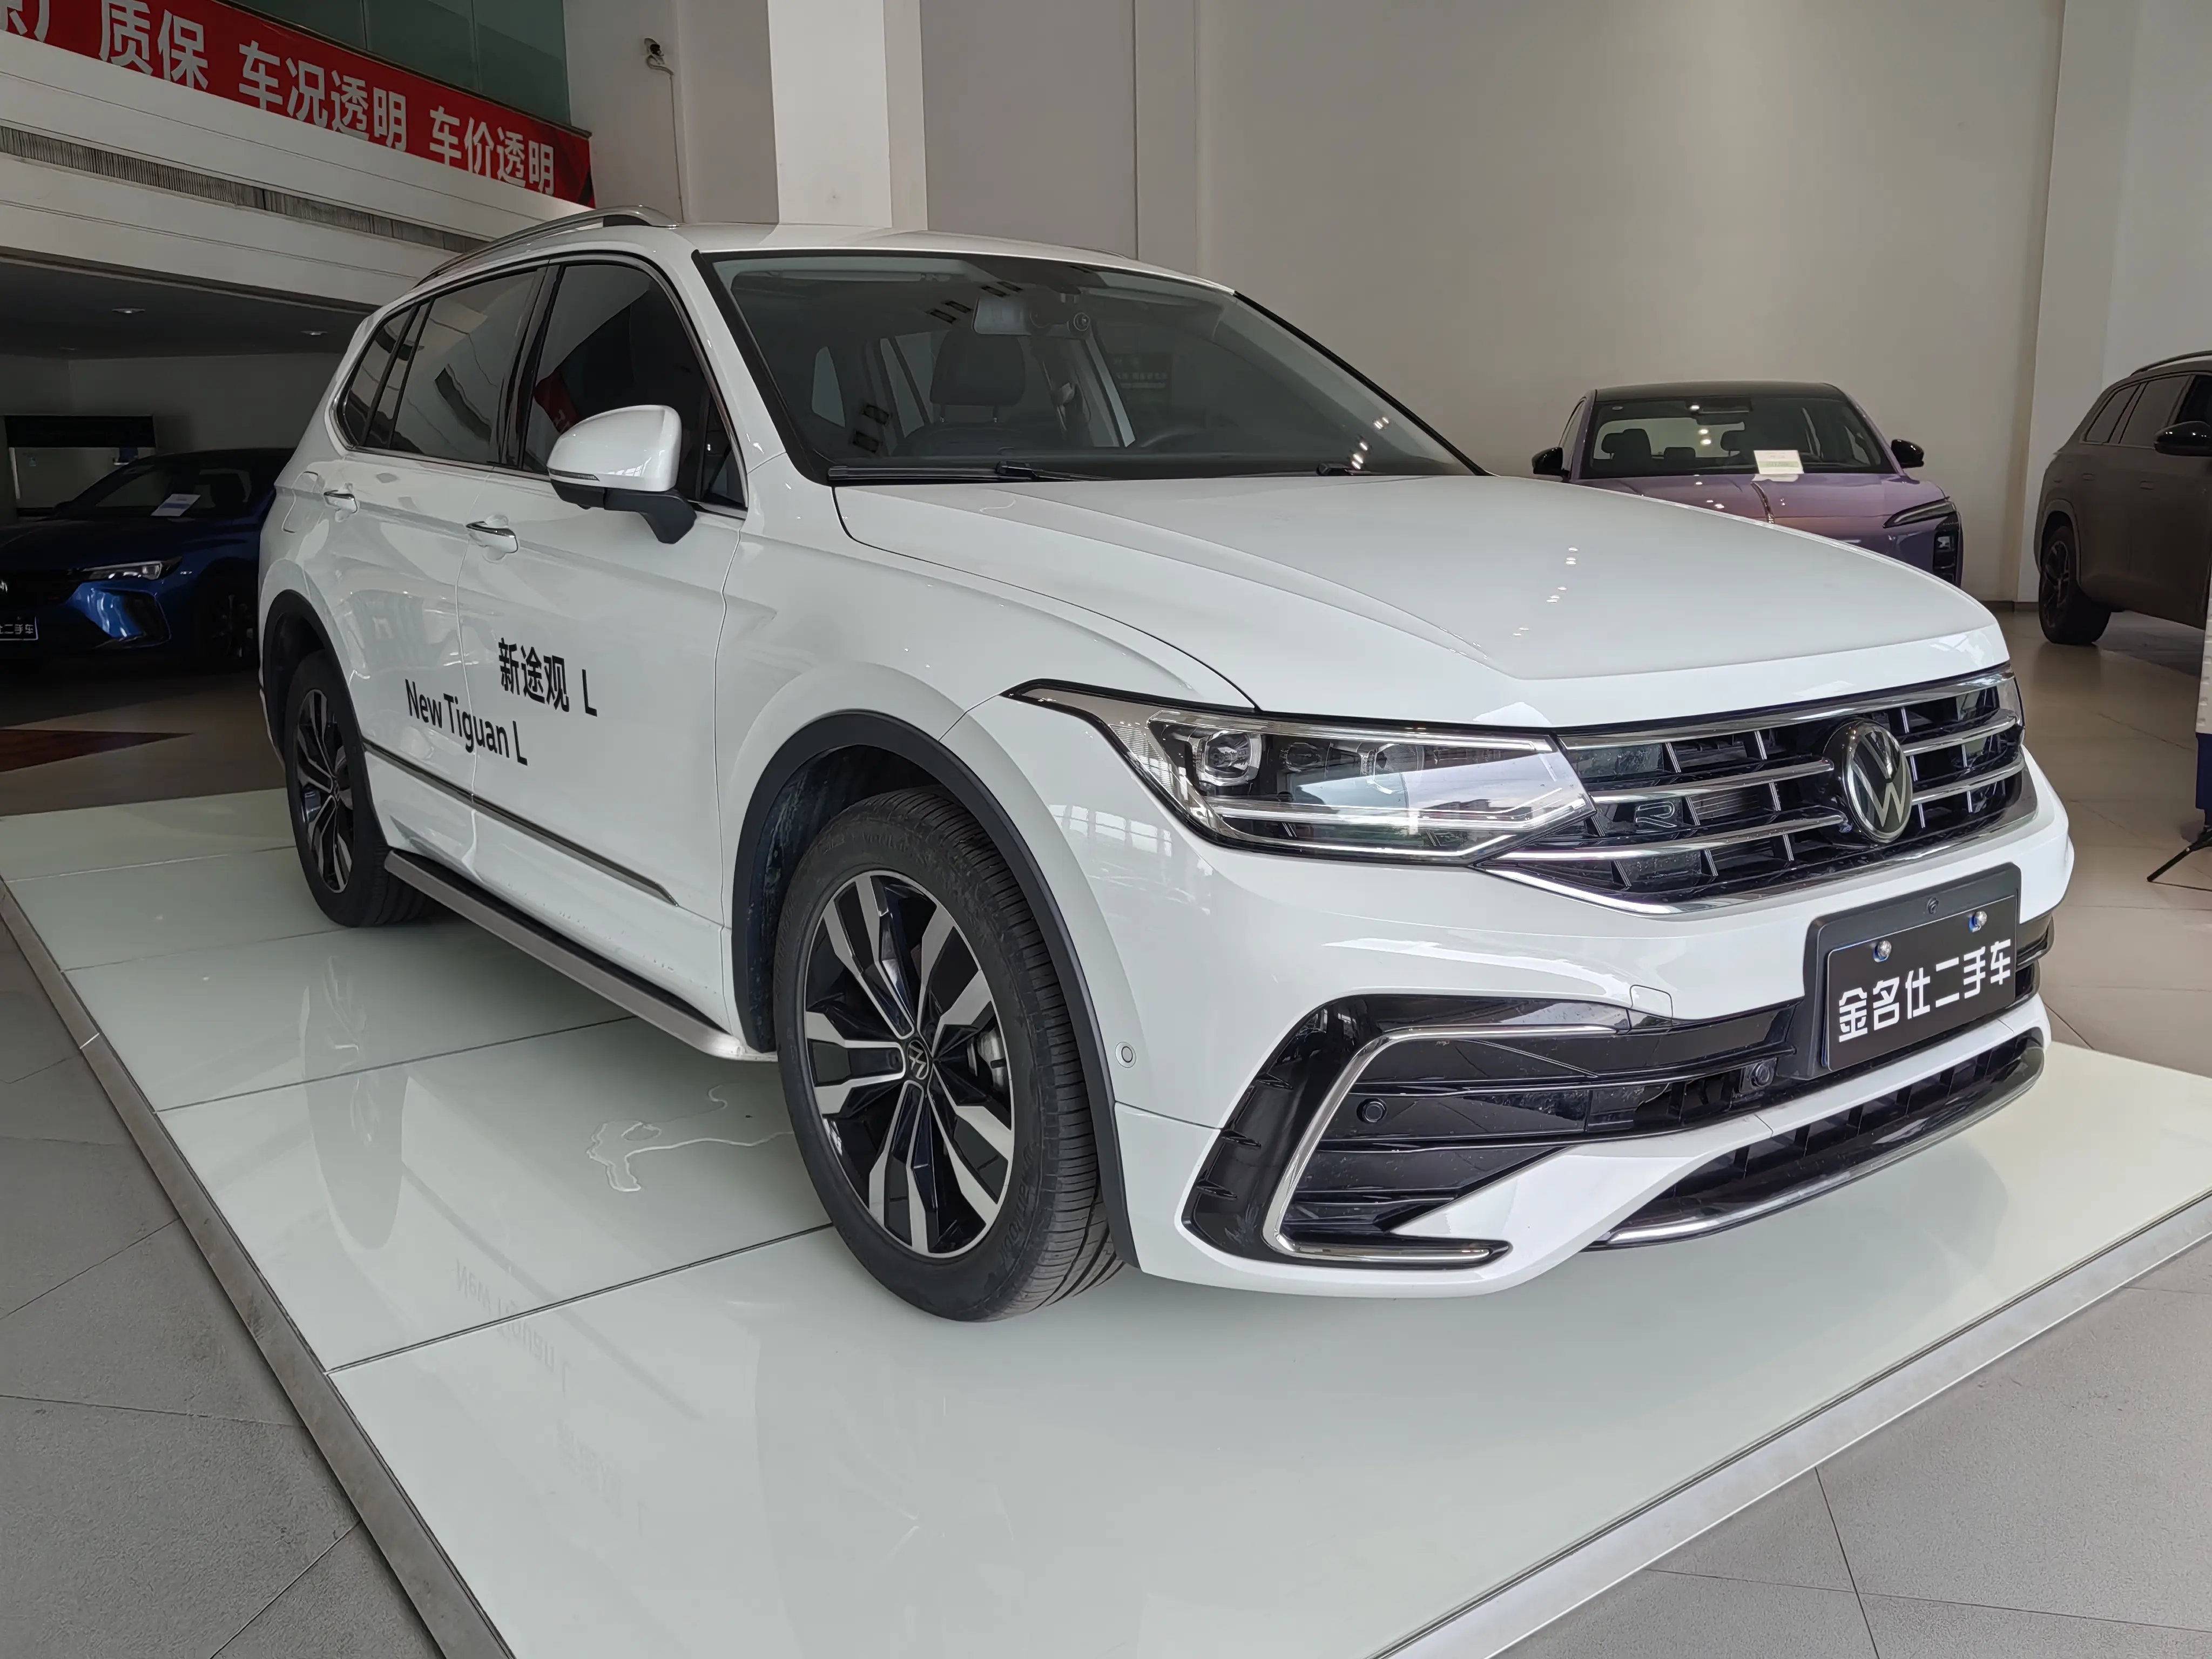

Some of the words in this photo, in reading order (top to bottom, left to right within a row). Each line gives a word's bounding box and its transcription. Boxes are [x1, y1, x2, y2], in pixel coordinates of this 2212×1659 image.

[99, 0, 208, 90] 质保
[238, 41, 407, 152] 车况透明
[430, 106, 554, 195] 车价透明
[405, 678, 442, 729] New
[443, 693, 510, 758] Tiguan
[512, 720, 528, 766] L
[498, 637, 570, 712] 新途观
[582, 669, 597, 717] L
[1839, 939, 2011, 1043] 金名仕二手车
